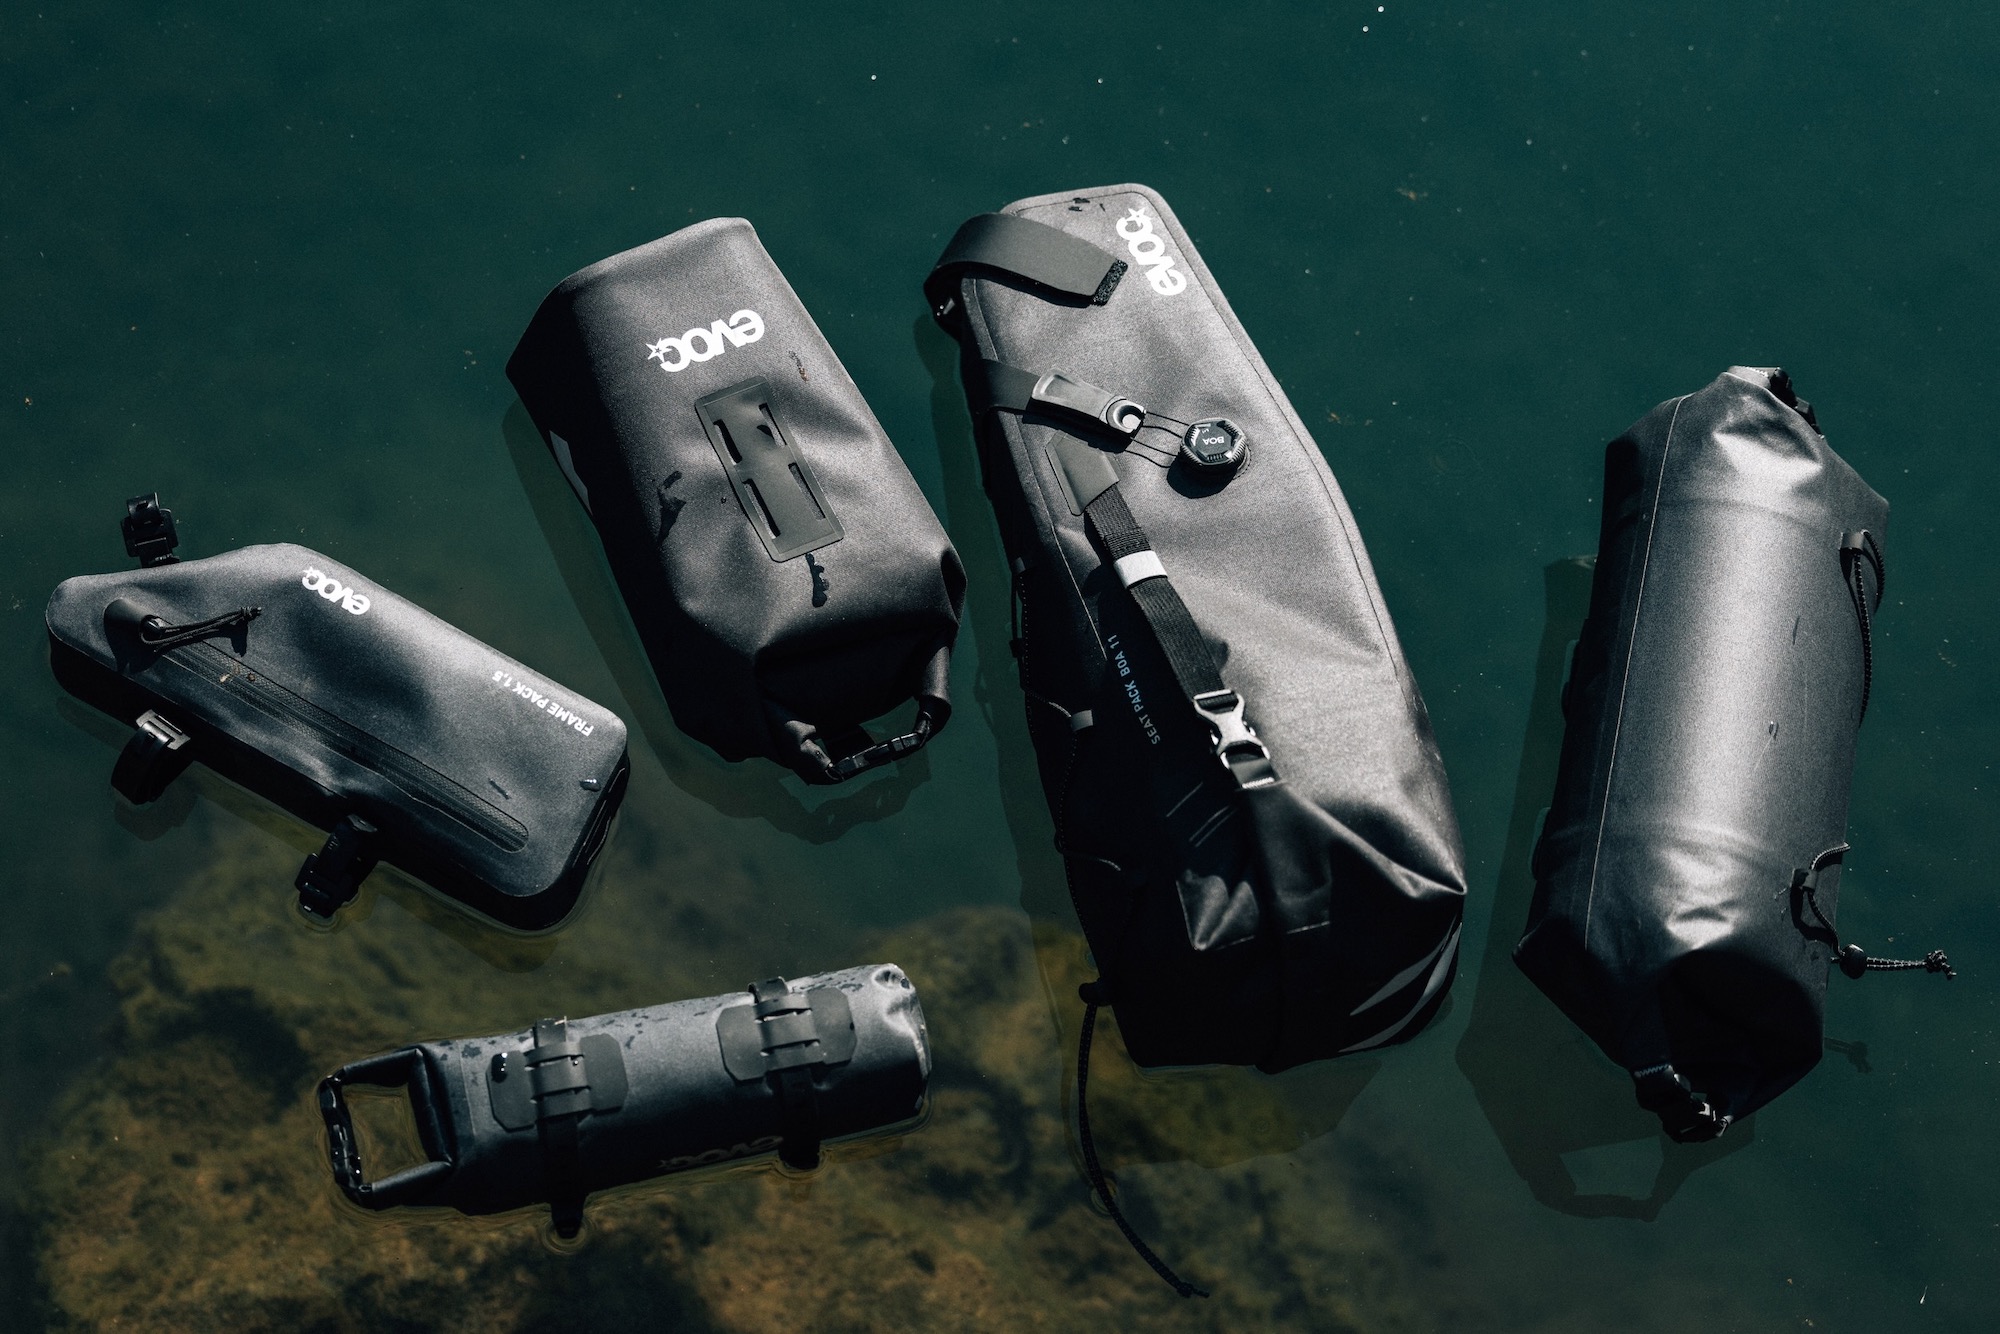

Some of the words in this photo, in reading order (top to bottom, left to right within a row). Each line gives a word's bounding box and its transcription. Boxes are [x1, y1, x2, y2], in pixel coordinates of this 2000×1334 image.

[1116, 208, 1187, 296] evoc
[646, 309, 766, 373] evoc
[1202, 436, 1225, 446] BOA
[301, 567, 370, 615] evoc
[1107, 634, 1120, 649] 11
[1115, 650, 1131, 677] BOA
[512, 682, 549, 709] PACK
[1124, 680, 1144, 712] PACK
[547, 702, 594, 737] FRAME
[1138, 714, 1161, 744] SEAT
